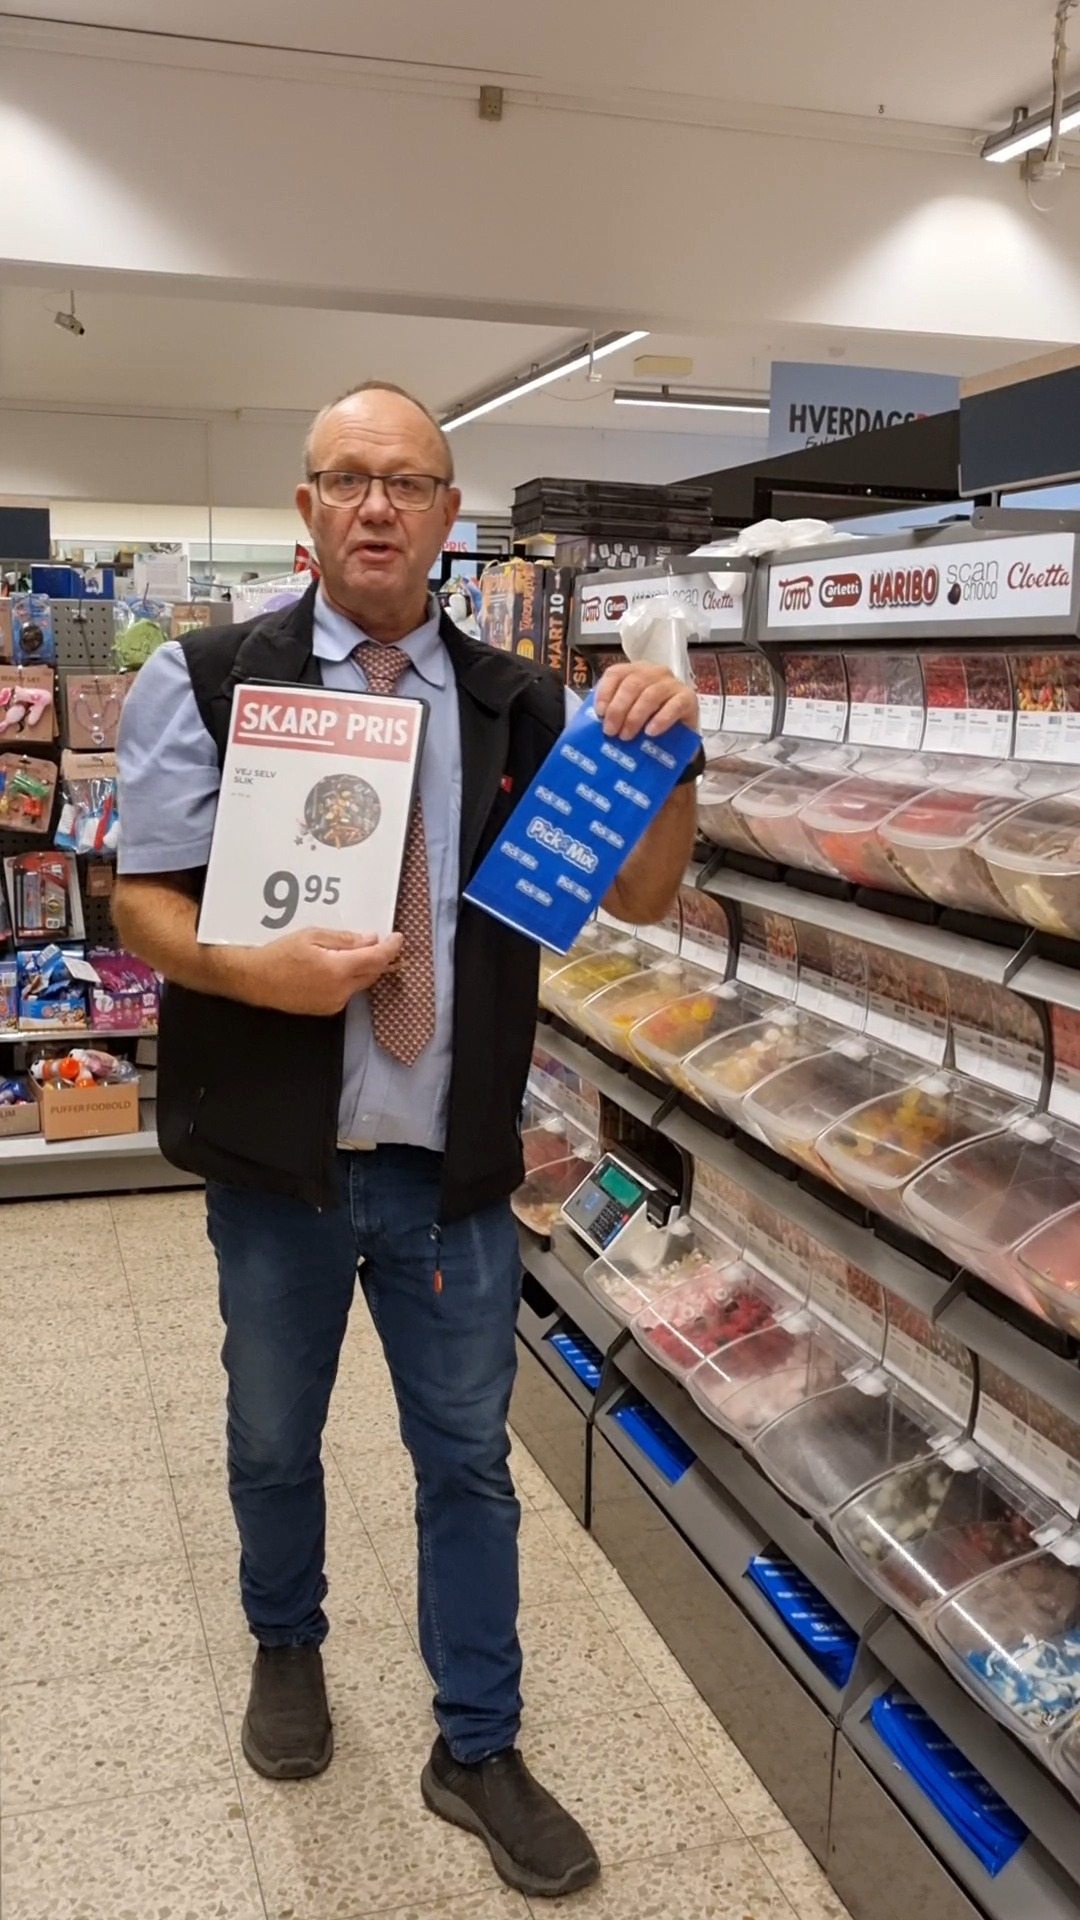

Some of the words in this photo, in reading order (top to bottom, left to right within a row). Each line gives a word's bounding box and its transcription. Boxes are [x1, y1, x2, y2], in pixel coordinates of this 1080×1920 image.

[947, 560, 998, 584] scan
[1007, 561, 1070, 590] Cloetta
[703, 589, 734, 610] Cloetta
[779, 576, 814, 611] Toms
[820, 577, 860, 604] Carletti
[868, 567, 939, 607] HARIBO
[963, 580, 997, 601] choco
[551, 594, 564, 615] 10
[549, 616, 564, 669] MART
[240, 702, 338, 737] SKARP
[346, 713, 408, 746] PRIS
[233, 776, 254, 785] SLIK
[234, 767, 252, 776] VEJ
[254, 770, 277, 779] SELV
[50, 1103, 85, 1114] PUFFER
[86, 1100, 131, 1113] FODBOLD
